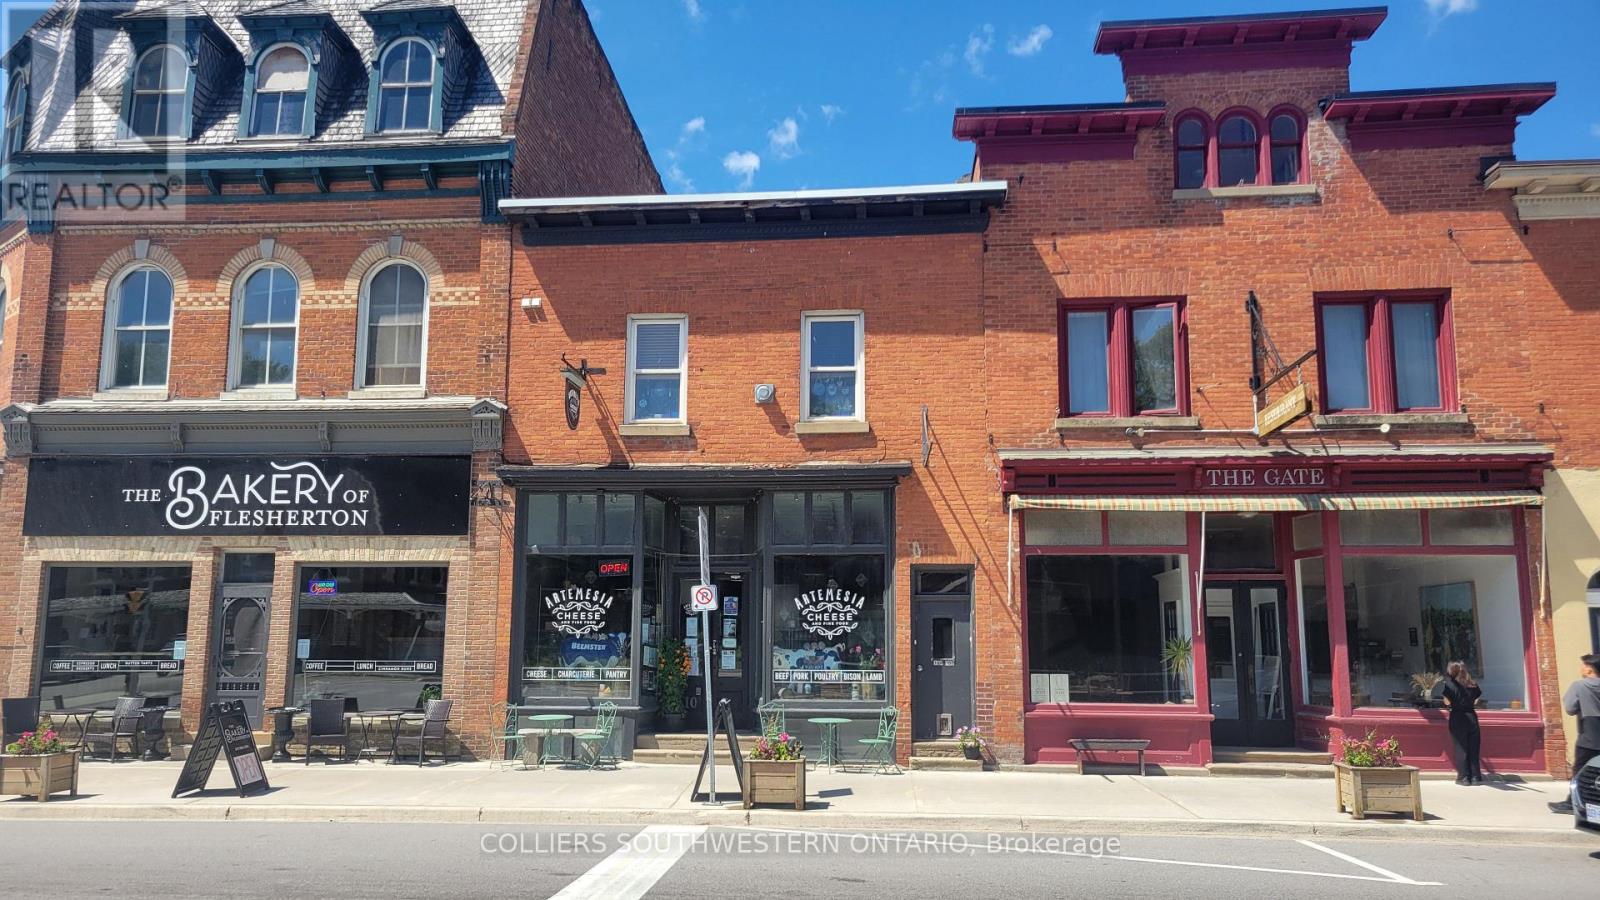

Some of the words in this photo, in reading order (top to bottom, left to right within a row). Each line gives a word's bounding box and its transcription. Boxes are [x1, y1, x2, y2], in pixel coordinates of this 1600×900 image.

[1206, 469, 1255, 486] THE
[1263, 468, 1325, 485] GATE
[122, 489, 161, 502] THE
[165, 461, 344, 530] BAKERY
[343, 489, 369, 503] OF
[208, 509, 369, 526] FLESHERTON
[600, 563, 629, 573] OPEN
[545, 587, 613, 609] ARTEMESIA
[794, 588, 865, 610] ARTEMESIA
[557, 612, 601, 620] CHEESE
[807, 613, 853, 621] CHEESE
[52, 662, 71, 670] COFFEE
[100, 662, 117, 670] LUNCH
[305, 662, 325, 670] COFFEE
[356, 662, 374, 670] LUNCH
[416, 662, 434, 670] BREAD
[526, 670, 548, 678] CHEESE
[557, 670, 595, 678] CHARCUTERIE
[606, 670, 628, 678] PANTRY
[775, 672, 789, 680] BEEF
[793, 672, 809, 680] PORK
[814, 672, 839, 680] POULTRY
[843, 672, 862, 680] BISON
[866, 672, 883, 681] LAMB
